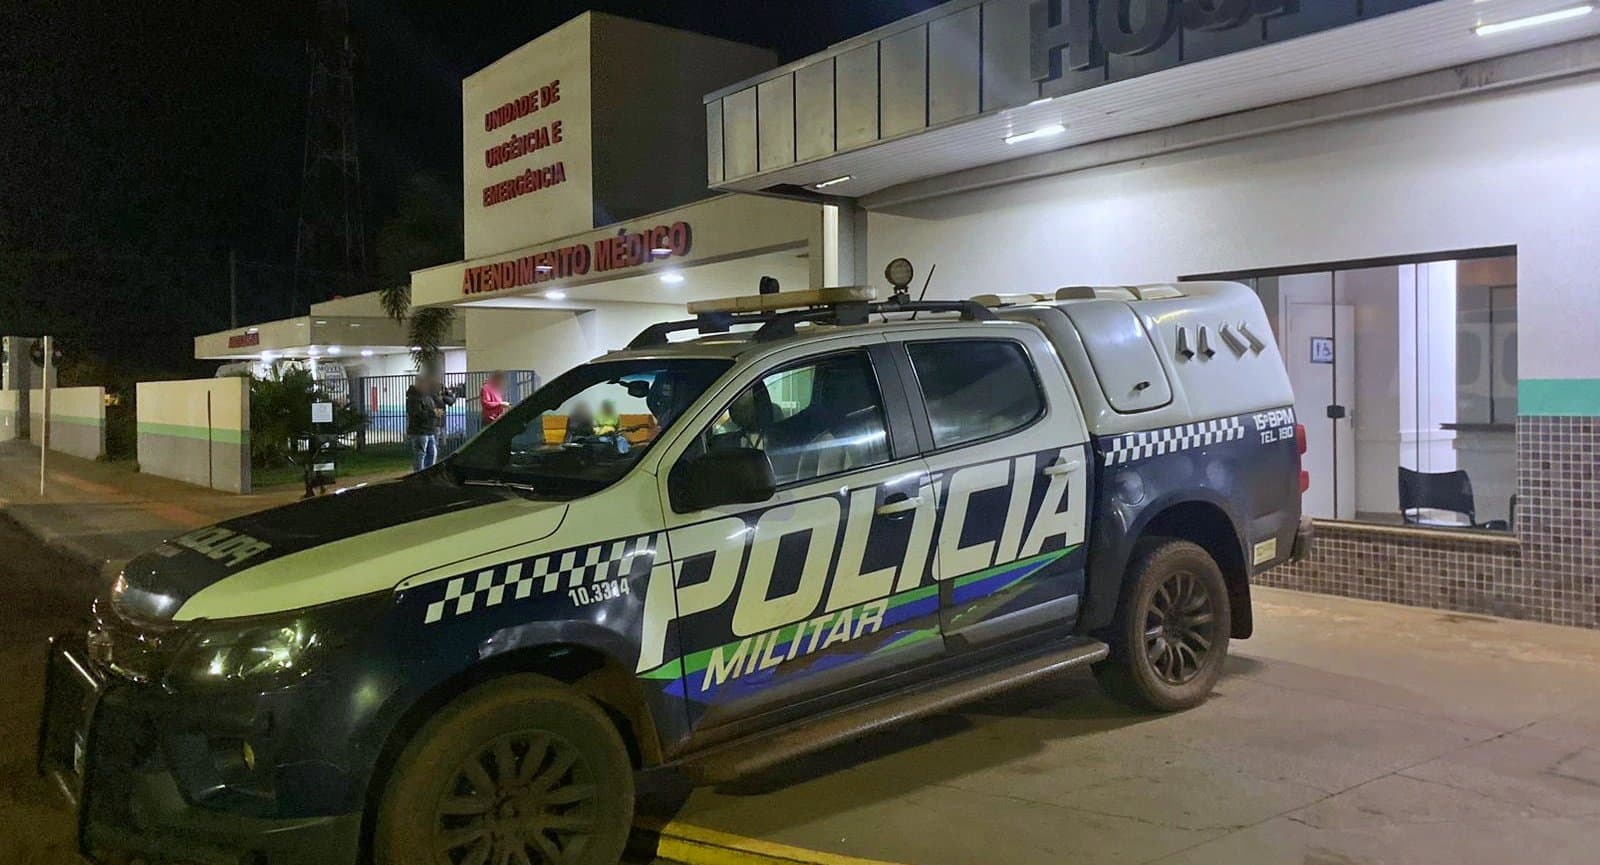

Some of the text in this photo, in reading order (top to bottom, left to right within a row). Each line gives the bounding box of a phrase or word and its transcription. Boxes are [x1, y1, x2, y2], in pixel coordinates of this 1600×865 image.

[484, 80, 560, 132] UNIDADE DE
[485, 121, 563, 168] URGÊNCIA E
[482, 161, 566, 207] EMERGÊNCIA
[463, 221, 692, 294] ATENDIMENTO MÉDICO
[1260, 425, 1294, 445] TEL 190
[636, 443, 1086, 674] POLÍCIA
[700, 599, 889, 692] MILITAR
